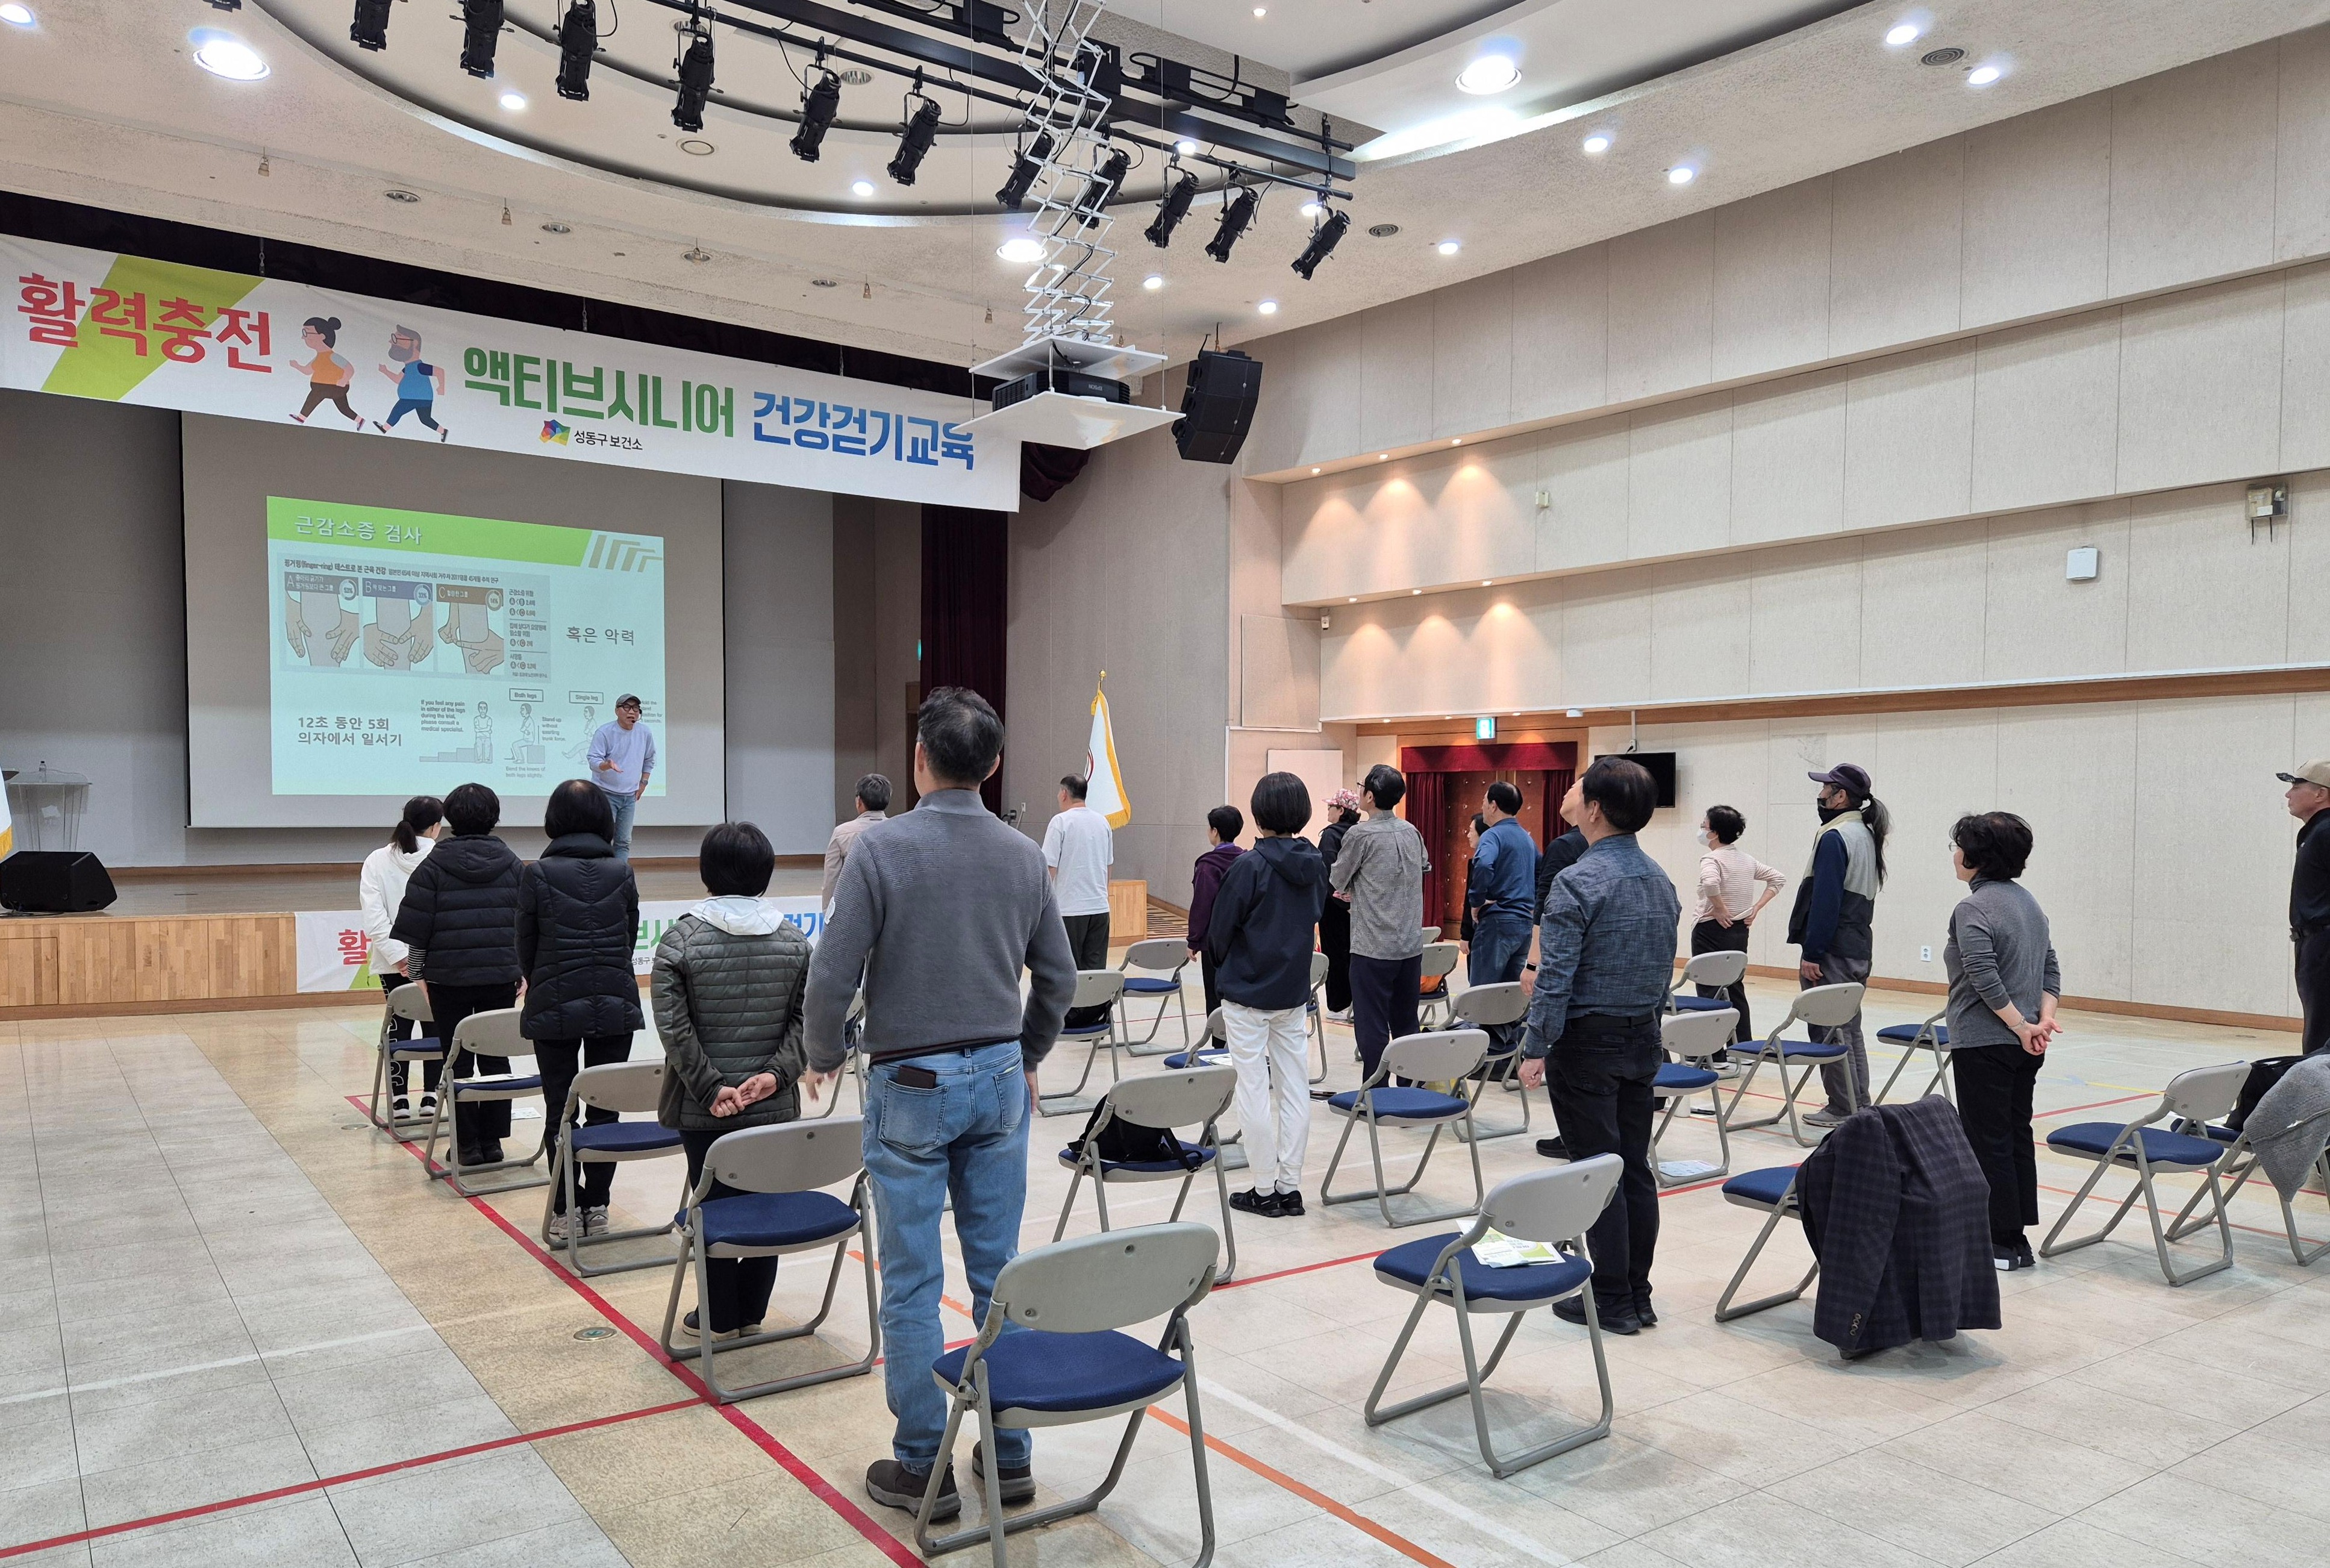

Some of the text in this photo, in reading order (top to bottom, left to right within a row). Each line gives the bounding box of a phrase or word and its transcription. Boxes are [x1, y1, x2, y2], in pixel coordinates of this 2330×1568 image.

[17, 273, 272, 373] 활력충전
[464, 347, 974, 471] 액티브시니어 건강걷기교육
[574, 430, 643, 450] 성동구 보건소
[295, 516, 422, 545] 근감소증 검사
[334, 563, 357, 572] 테스트로
[357, 565, 363, 573] 본
[364, 566, 375, 575] 근육
[375, 566, 387, 575] 건강
[286, 575, 294, 588] A
[365, 581, 372, 593] B
[439, 586, 446, 598] C
[566, 626, 634, 646] 혹은 악력
[298, 716, 389, 731] 12초 동안 5회
[298, 731, 402, 746] 의자에서 일서기
